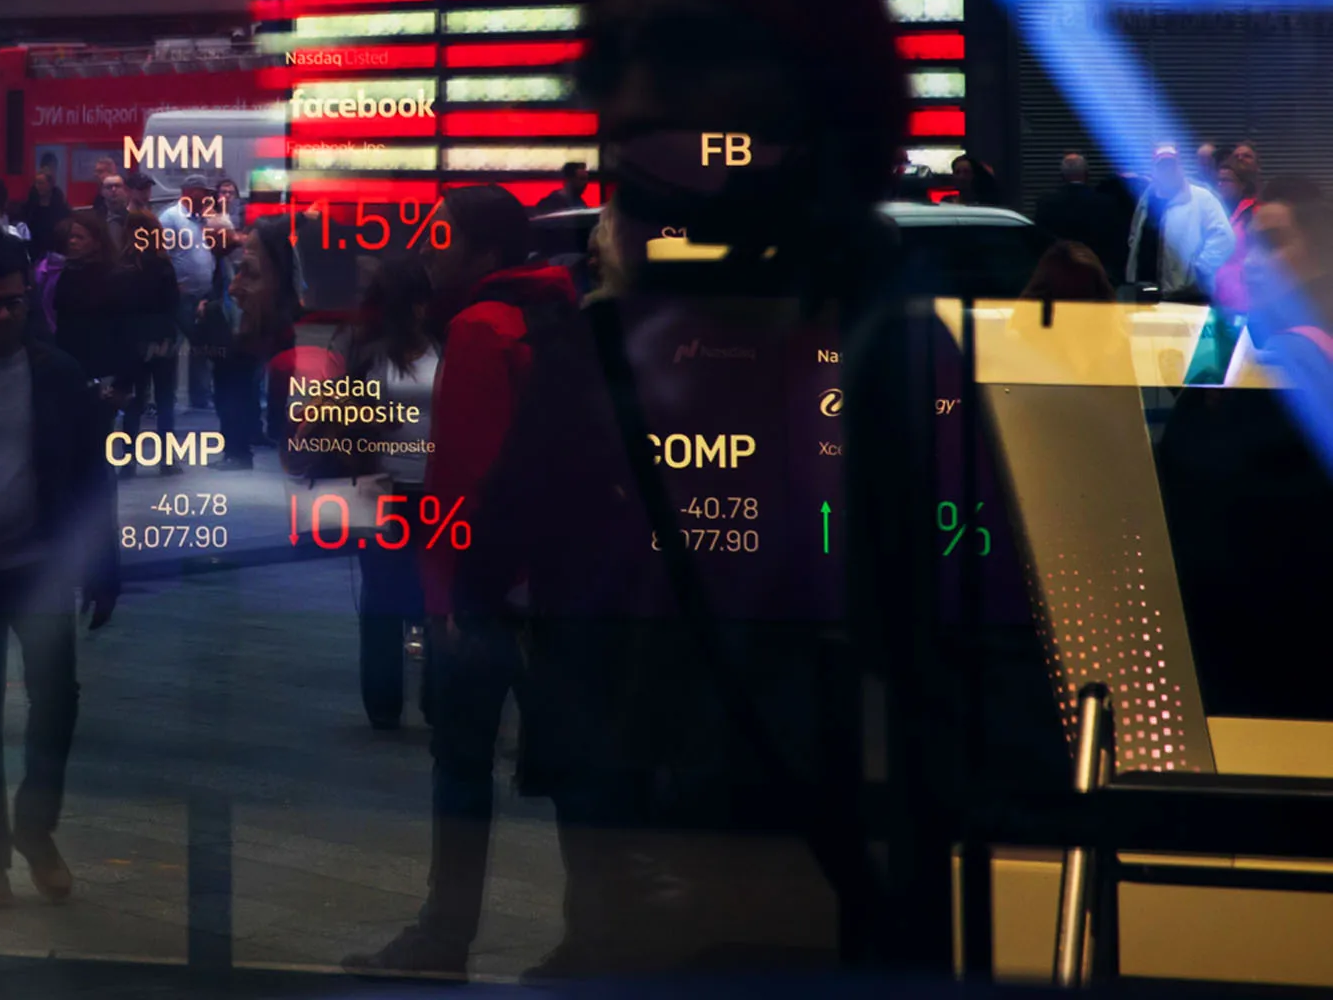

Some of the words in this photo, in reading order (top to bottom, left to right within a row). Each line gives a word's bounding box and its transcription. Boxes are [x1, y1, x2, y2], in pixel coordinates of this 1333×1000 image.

[285, 50, 342, 68] Nasdaq
[344, 50, 389, 66] Listed
[290, 88, 436, 119] facebook
[123, 135, 223, 170] MMM
[700, 131, 754, 168] FB
[314, 196, 452, 251] 1.5%
[133, 227, 228, 253] $190.51
[288, 375, 381, 402] Nasdaq
[288, 401, 421, 427] Composite
[104, 431, 226, 468] COMP
[287, 437, 353, 456] NASDAQ
[356, 437, 436, 457] Composite
[150, 493, 228, 518] -40.78
[679, 496, 760, 521] -40.78
[312, 494, 473, 552] 0.5%
[121, 526, 228, 553] 8,077.90
